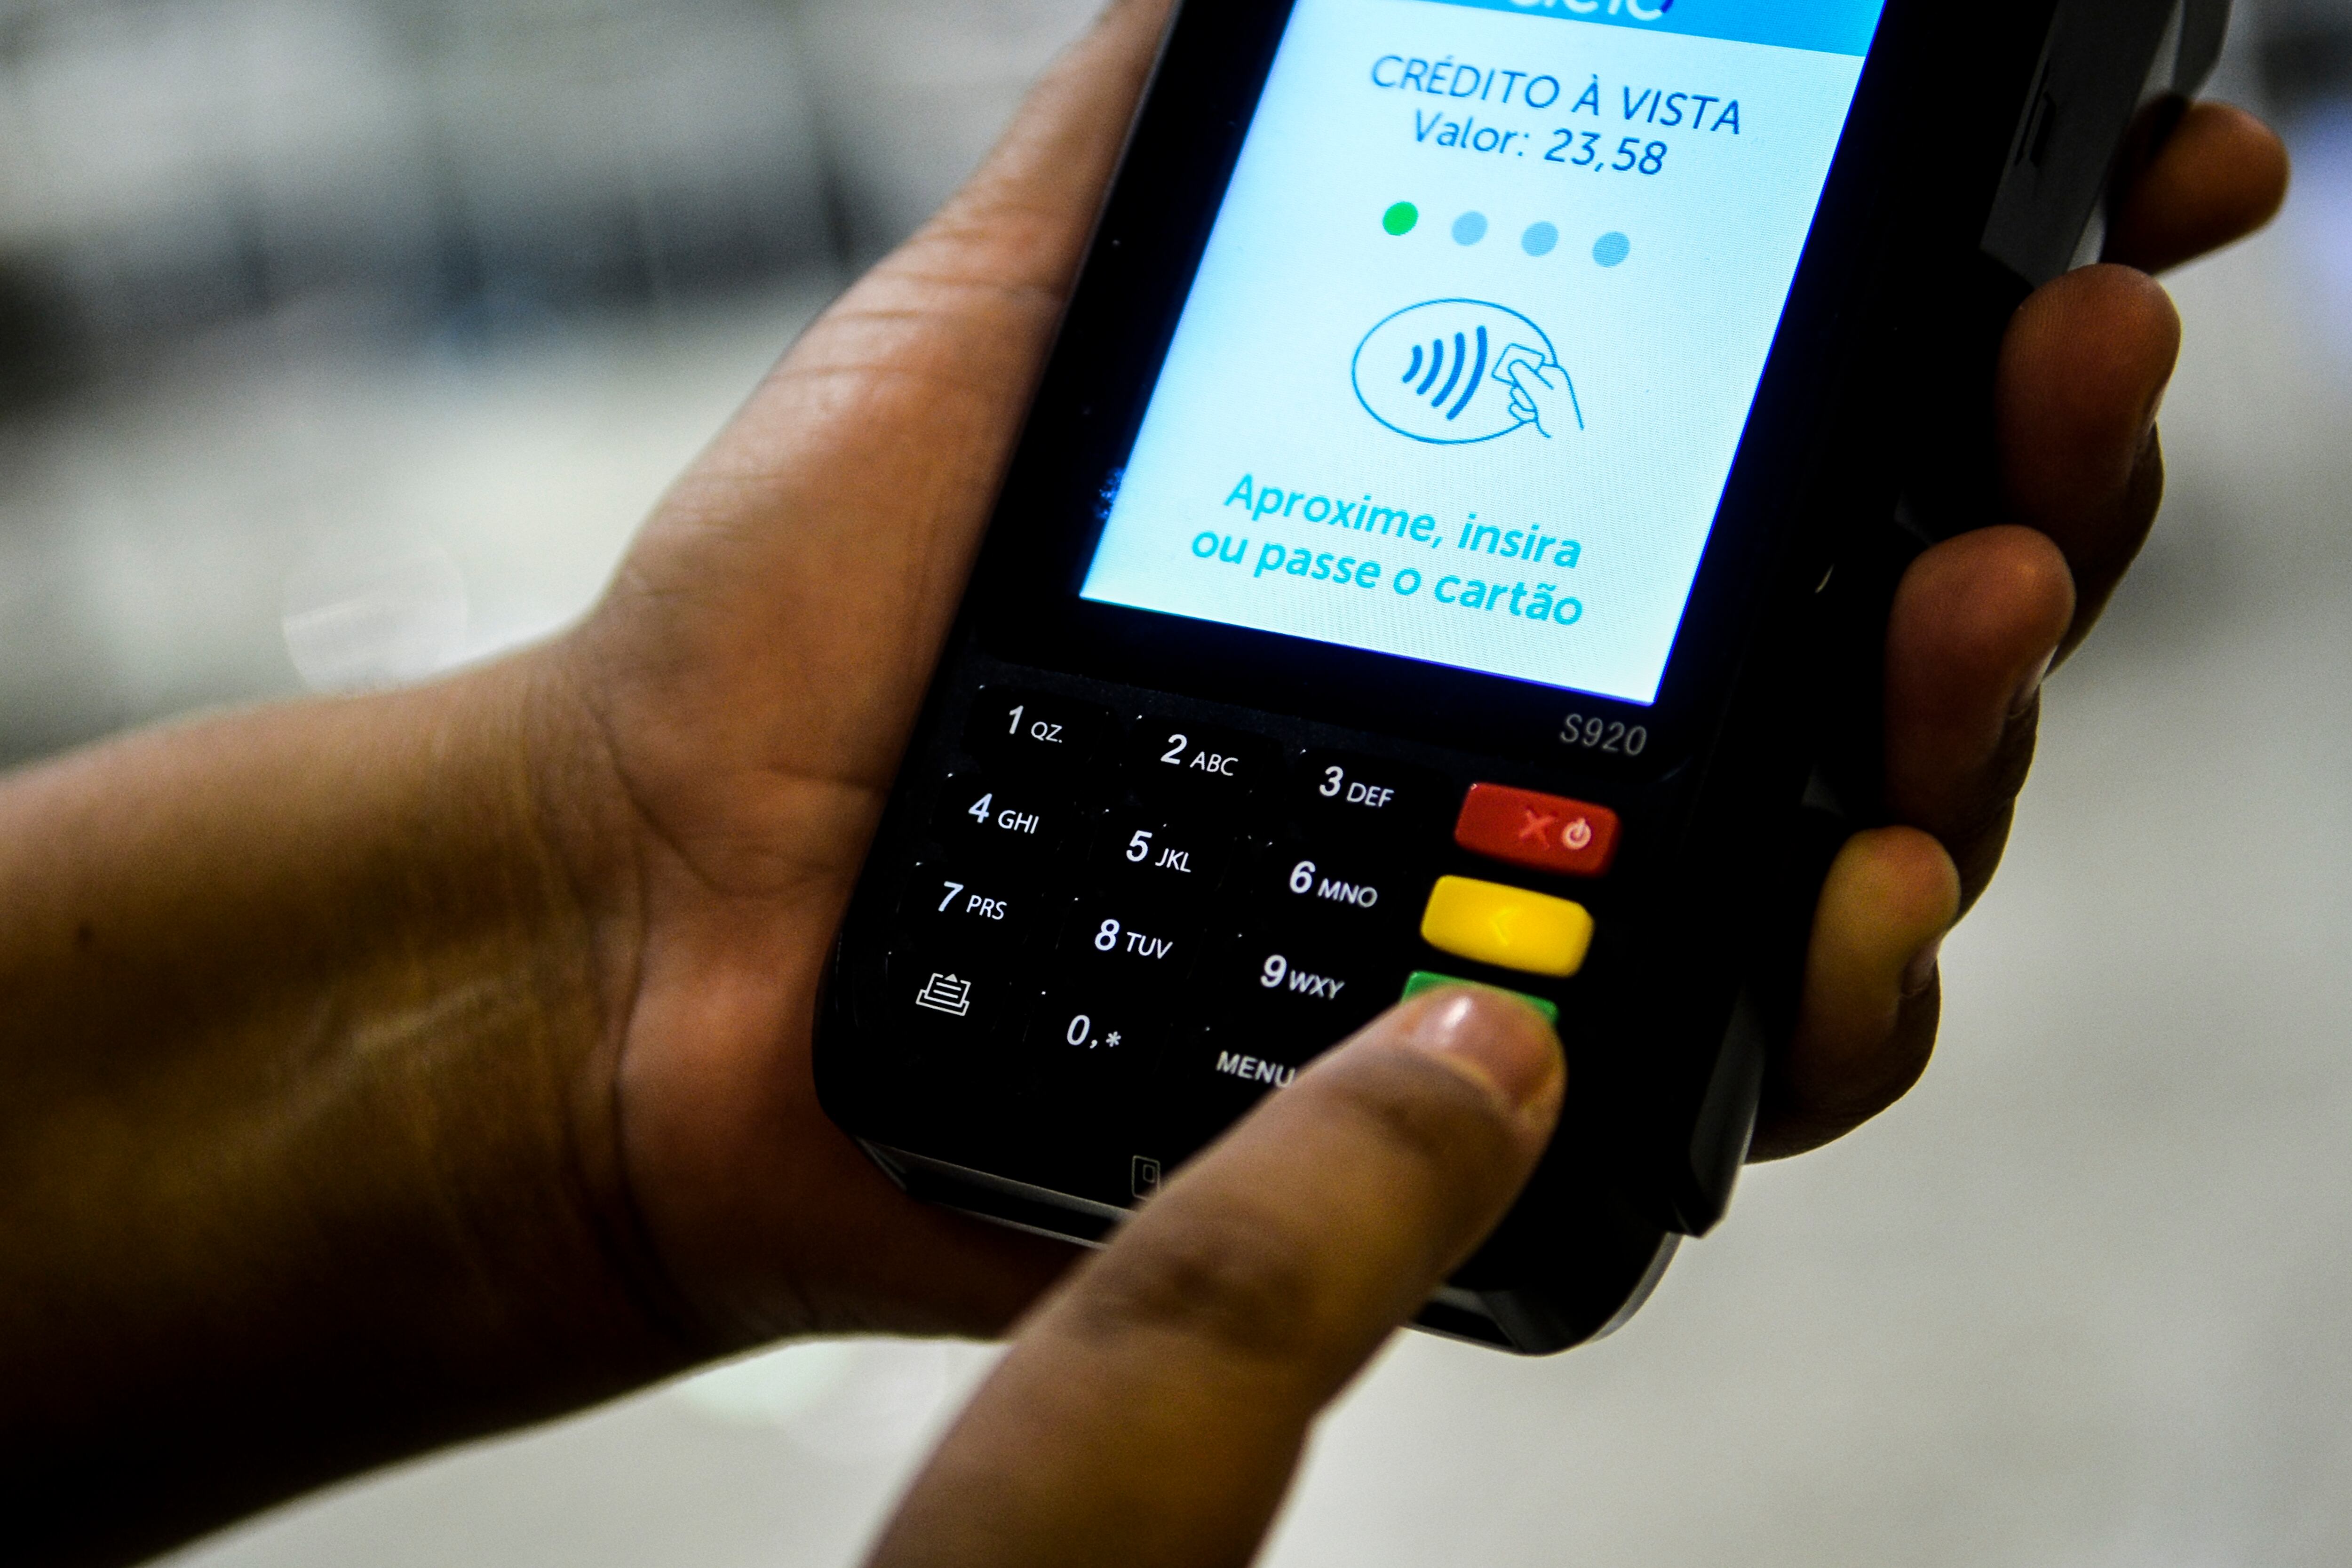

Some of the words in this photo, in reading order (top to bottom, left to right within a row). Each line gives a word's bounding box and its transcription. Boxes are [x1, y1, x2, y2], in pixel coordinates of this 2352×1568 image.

[1370, 54, 1561, 109] CRÉDITO
[1571, 73, 1599, 116] À
[1622, 85, 1740, 135] VISTA
[1414, 109, 1530, 154] Valor:
[1543, 127, 1668, 175] 23,58
[1224, 473, 1442, 549] Aproxime,
[1458, 512, 1582, 569] insira
[1191, 530, 1248, 565] ou
[1253, 543, 1381, 589] passe
[1392, 568, 1422, 596] o
[1434, 575, 1583, 626] cartão
[1009, 705, 1024, 734] 1
[1560, 713, 1647, 756] S920
[1160, 734, 1187, 765] 2
[1190, 751, 1239, 776] ABC
[1319, 766, 1344, 796] 3
[1346, 782, 1394, 807] DEF
[968, 793, 992, 823] 4
[998, 810, 1039, 834] GHI
[1126, 830, 1152, 862] 5
[1155, 848, 1191, 873] JKL
[938, 881, 964, 912] 7
[966, 894, 1007, 920] PRS
[1289, 860, 1316, 894] 6
[1318, 878, 1378, 907] MNO
[1094, 919, 1120, 951] 8
[1127, 931, 1173, 959] TUV
[1260, 955, 1287, 988] 9
[1289, 970, 1344, 999] WXY
[1216, 1051, 1296, 1090] MENU
